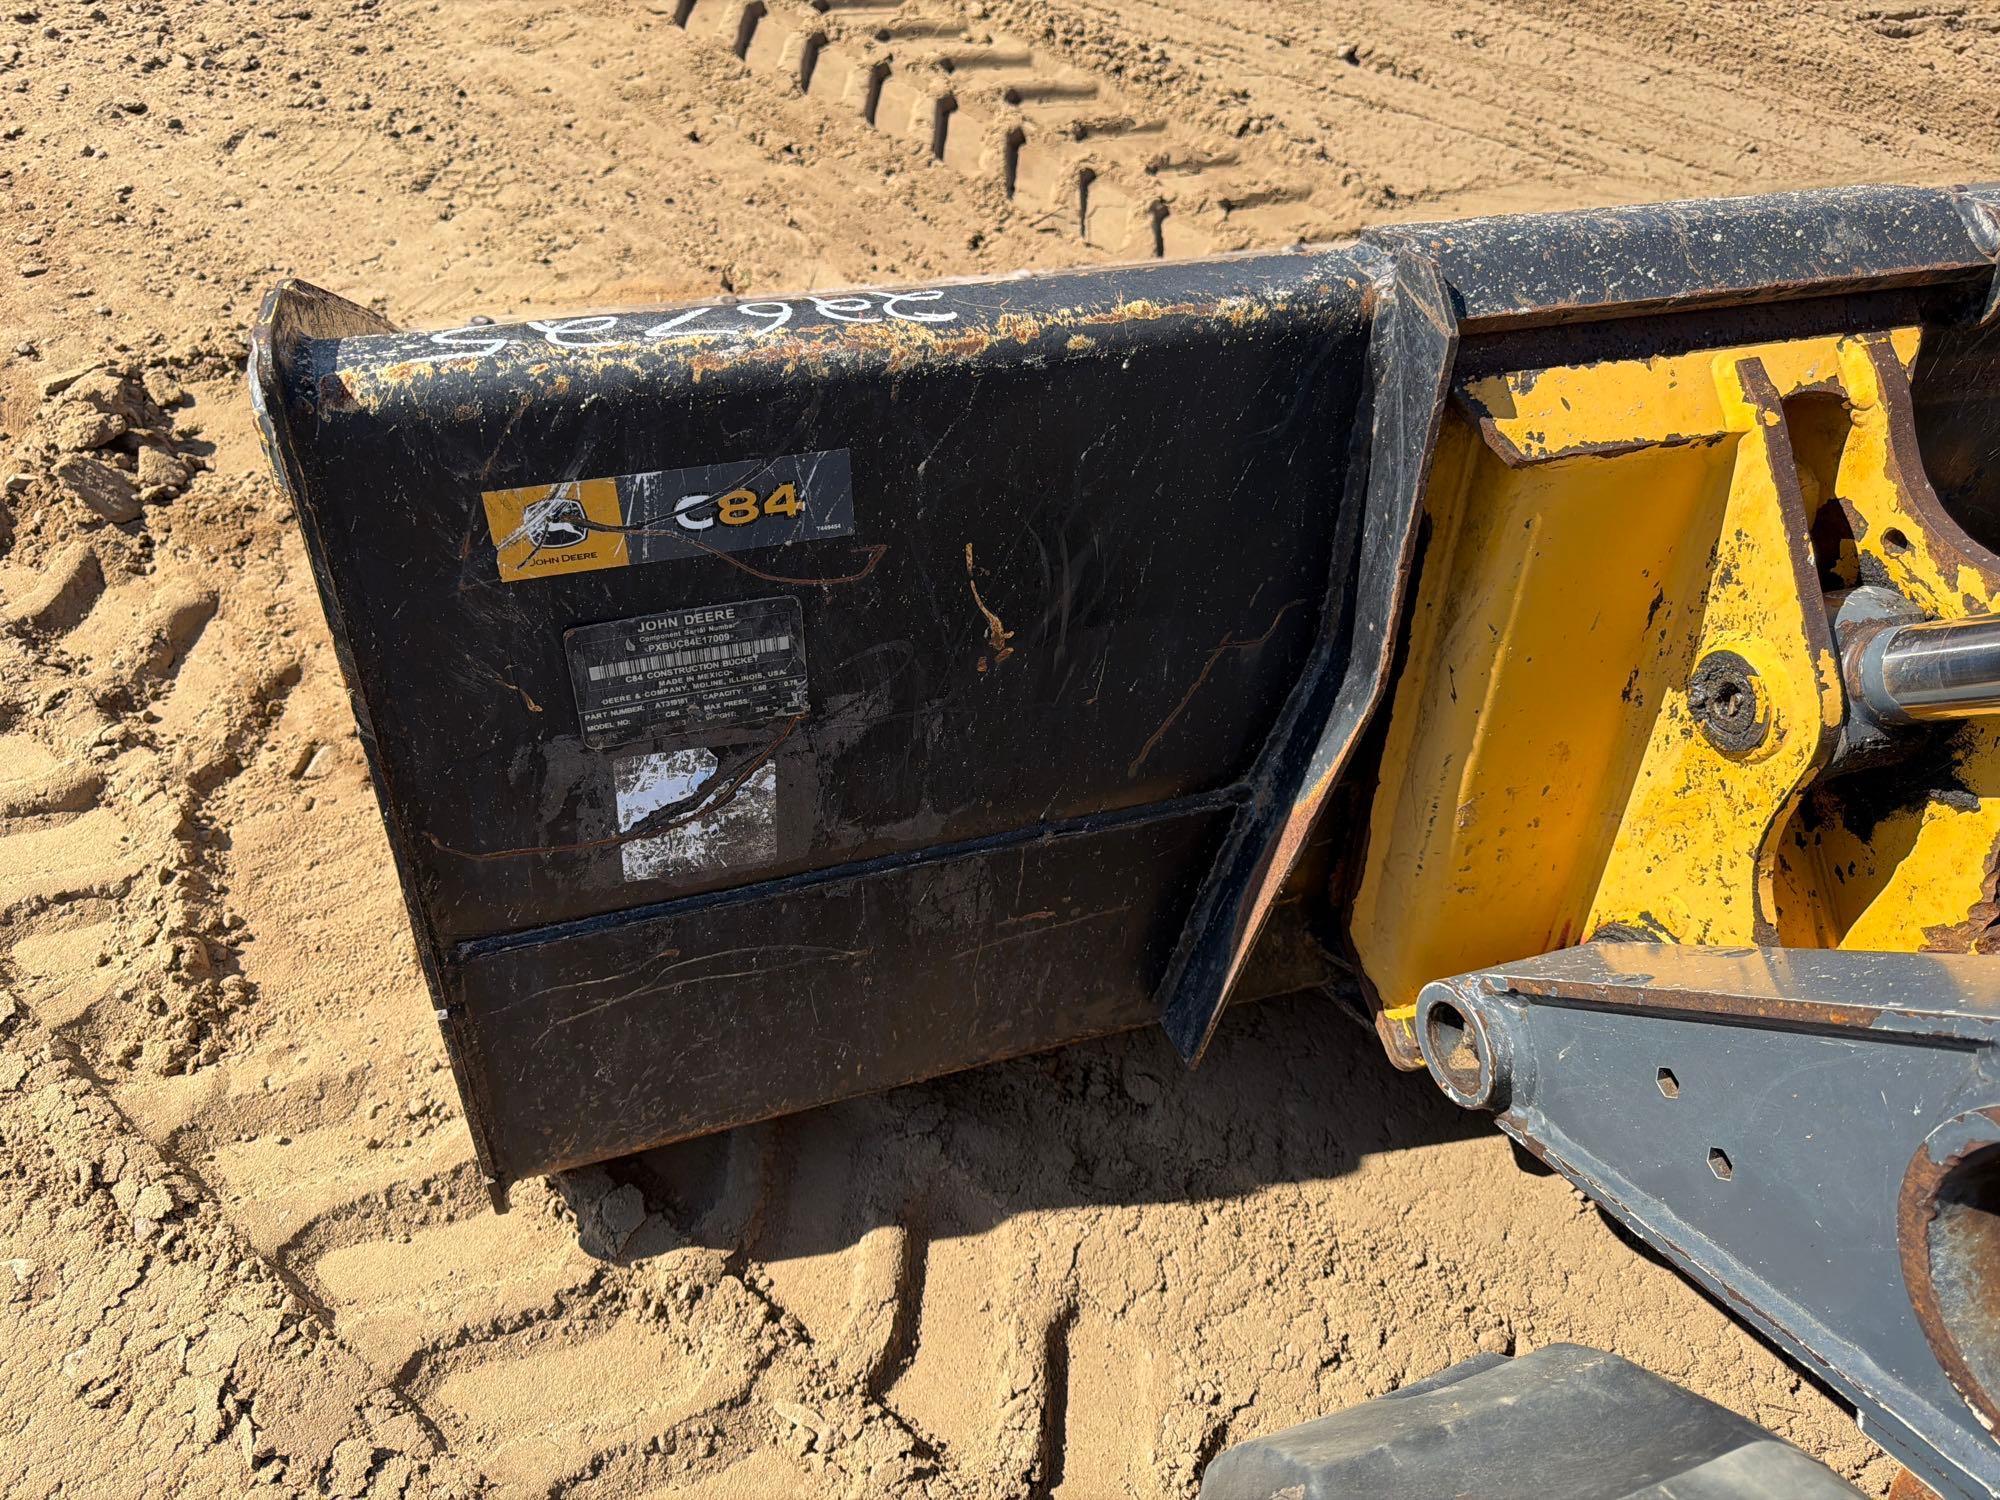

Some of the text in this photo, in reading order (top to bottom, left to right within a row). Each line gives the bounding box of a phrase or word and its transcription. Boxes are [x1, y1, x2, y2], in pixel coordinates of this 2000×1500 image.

[400, 290, 958, 363] 226725
[673, 480, 805, 531] C84
[529, 551, 599, 567] JOHN DEERE
[638, 609, 735, 632] JOHN DEERE
[639, 623, 734, 643] Component Serial Number
[625, 654, 759, 684] C84 CONSTRUCTION BUCKET
[658, 671, 730, 688] MADE IN MEXICO
[602, 694, 632, 706] DEERE
[634, 692, 641, 700] &
[728, 672, 766, 685] ILLINOIS,
[702, 688, 745, 701] CAPACITY:
[665, 710, 681, 719] C84
[703, 701, 722, 712] MAX
[584, 712, 608, 722] PART
[587, 722, 615, 733] MODEL
[617, 719, 632, 728] NO:
